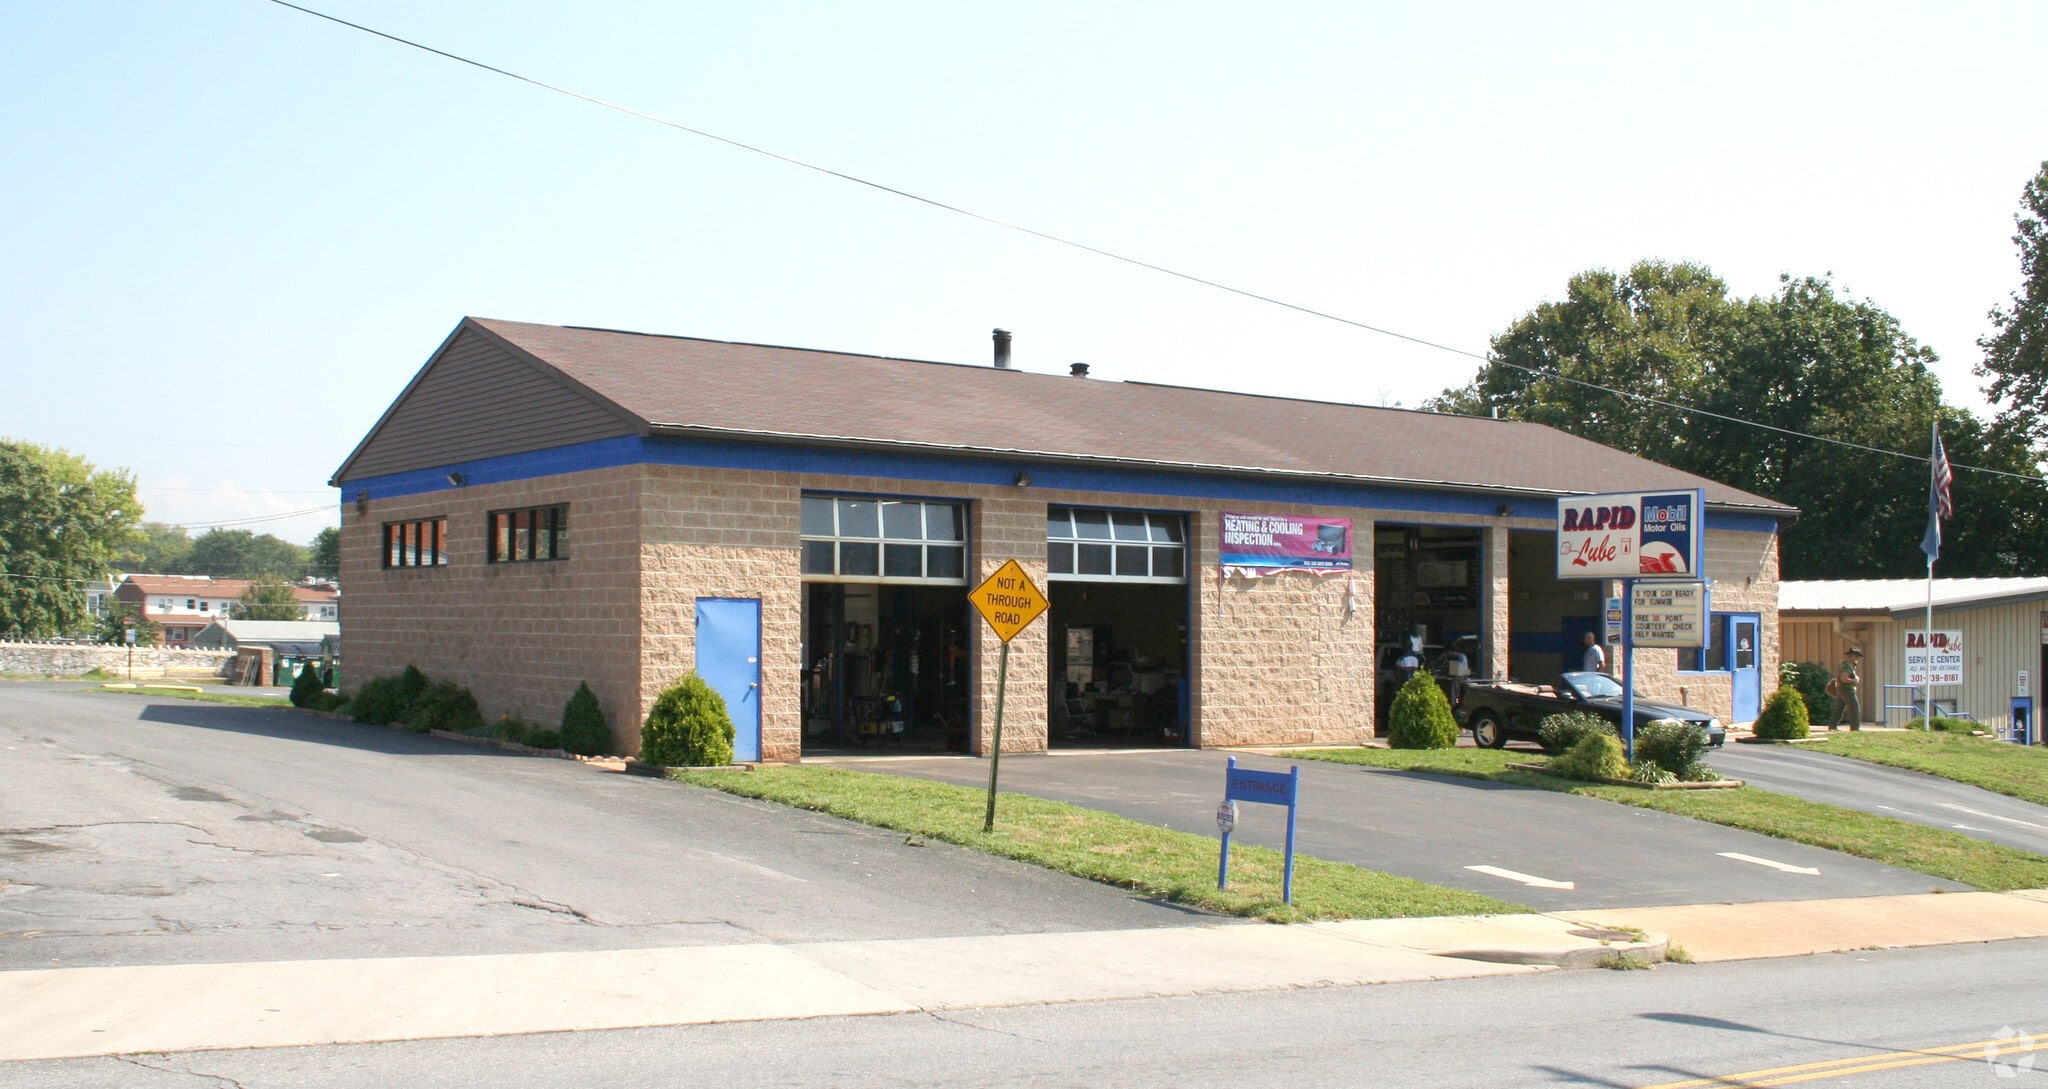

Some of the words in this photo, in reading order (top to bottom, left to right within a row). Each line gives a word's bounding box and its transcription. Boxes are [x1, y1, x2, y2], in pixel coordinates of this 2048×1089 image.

[1563, 505, 1636, 532] RAPID
[1643, 504, 1687, 522] Mobil
[1224, 518, 1260, 533] HEATING
[1261, 521, 1268, 533] &
[1269, 521, 1304, 535] COOLING
[1643, 524, 1666, 532] Motor
[1670, 522, 1687, 532] Oils
[1224, 531, 1273, 546] INSPECTION
[1572, 534, 1617, 567] Lube
[996, 577, 1016, 590] NOT
[1018, 580, 1026, 591] A
[986, 593, 1032, 609] THROUGH
[1675, 590, 1694, 598] READY
[994, 611, 1020, 625] ROAD
[1665, 614, 1683, 622] POINT
[1635, 622, 1666, 630] COURTESY
[1907, 655, 1935, 664] SERVIE
[1937, 655, 1961, 664] CENTER
[1232, 779, 1287, 794] ENTRANCE
